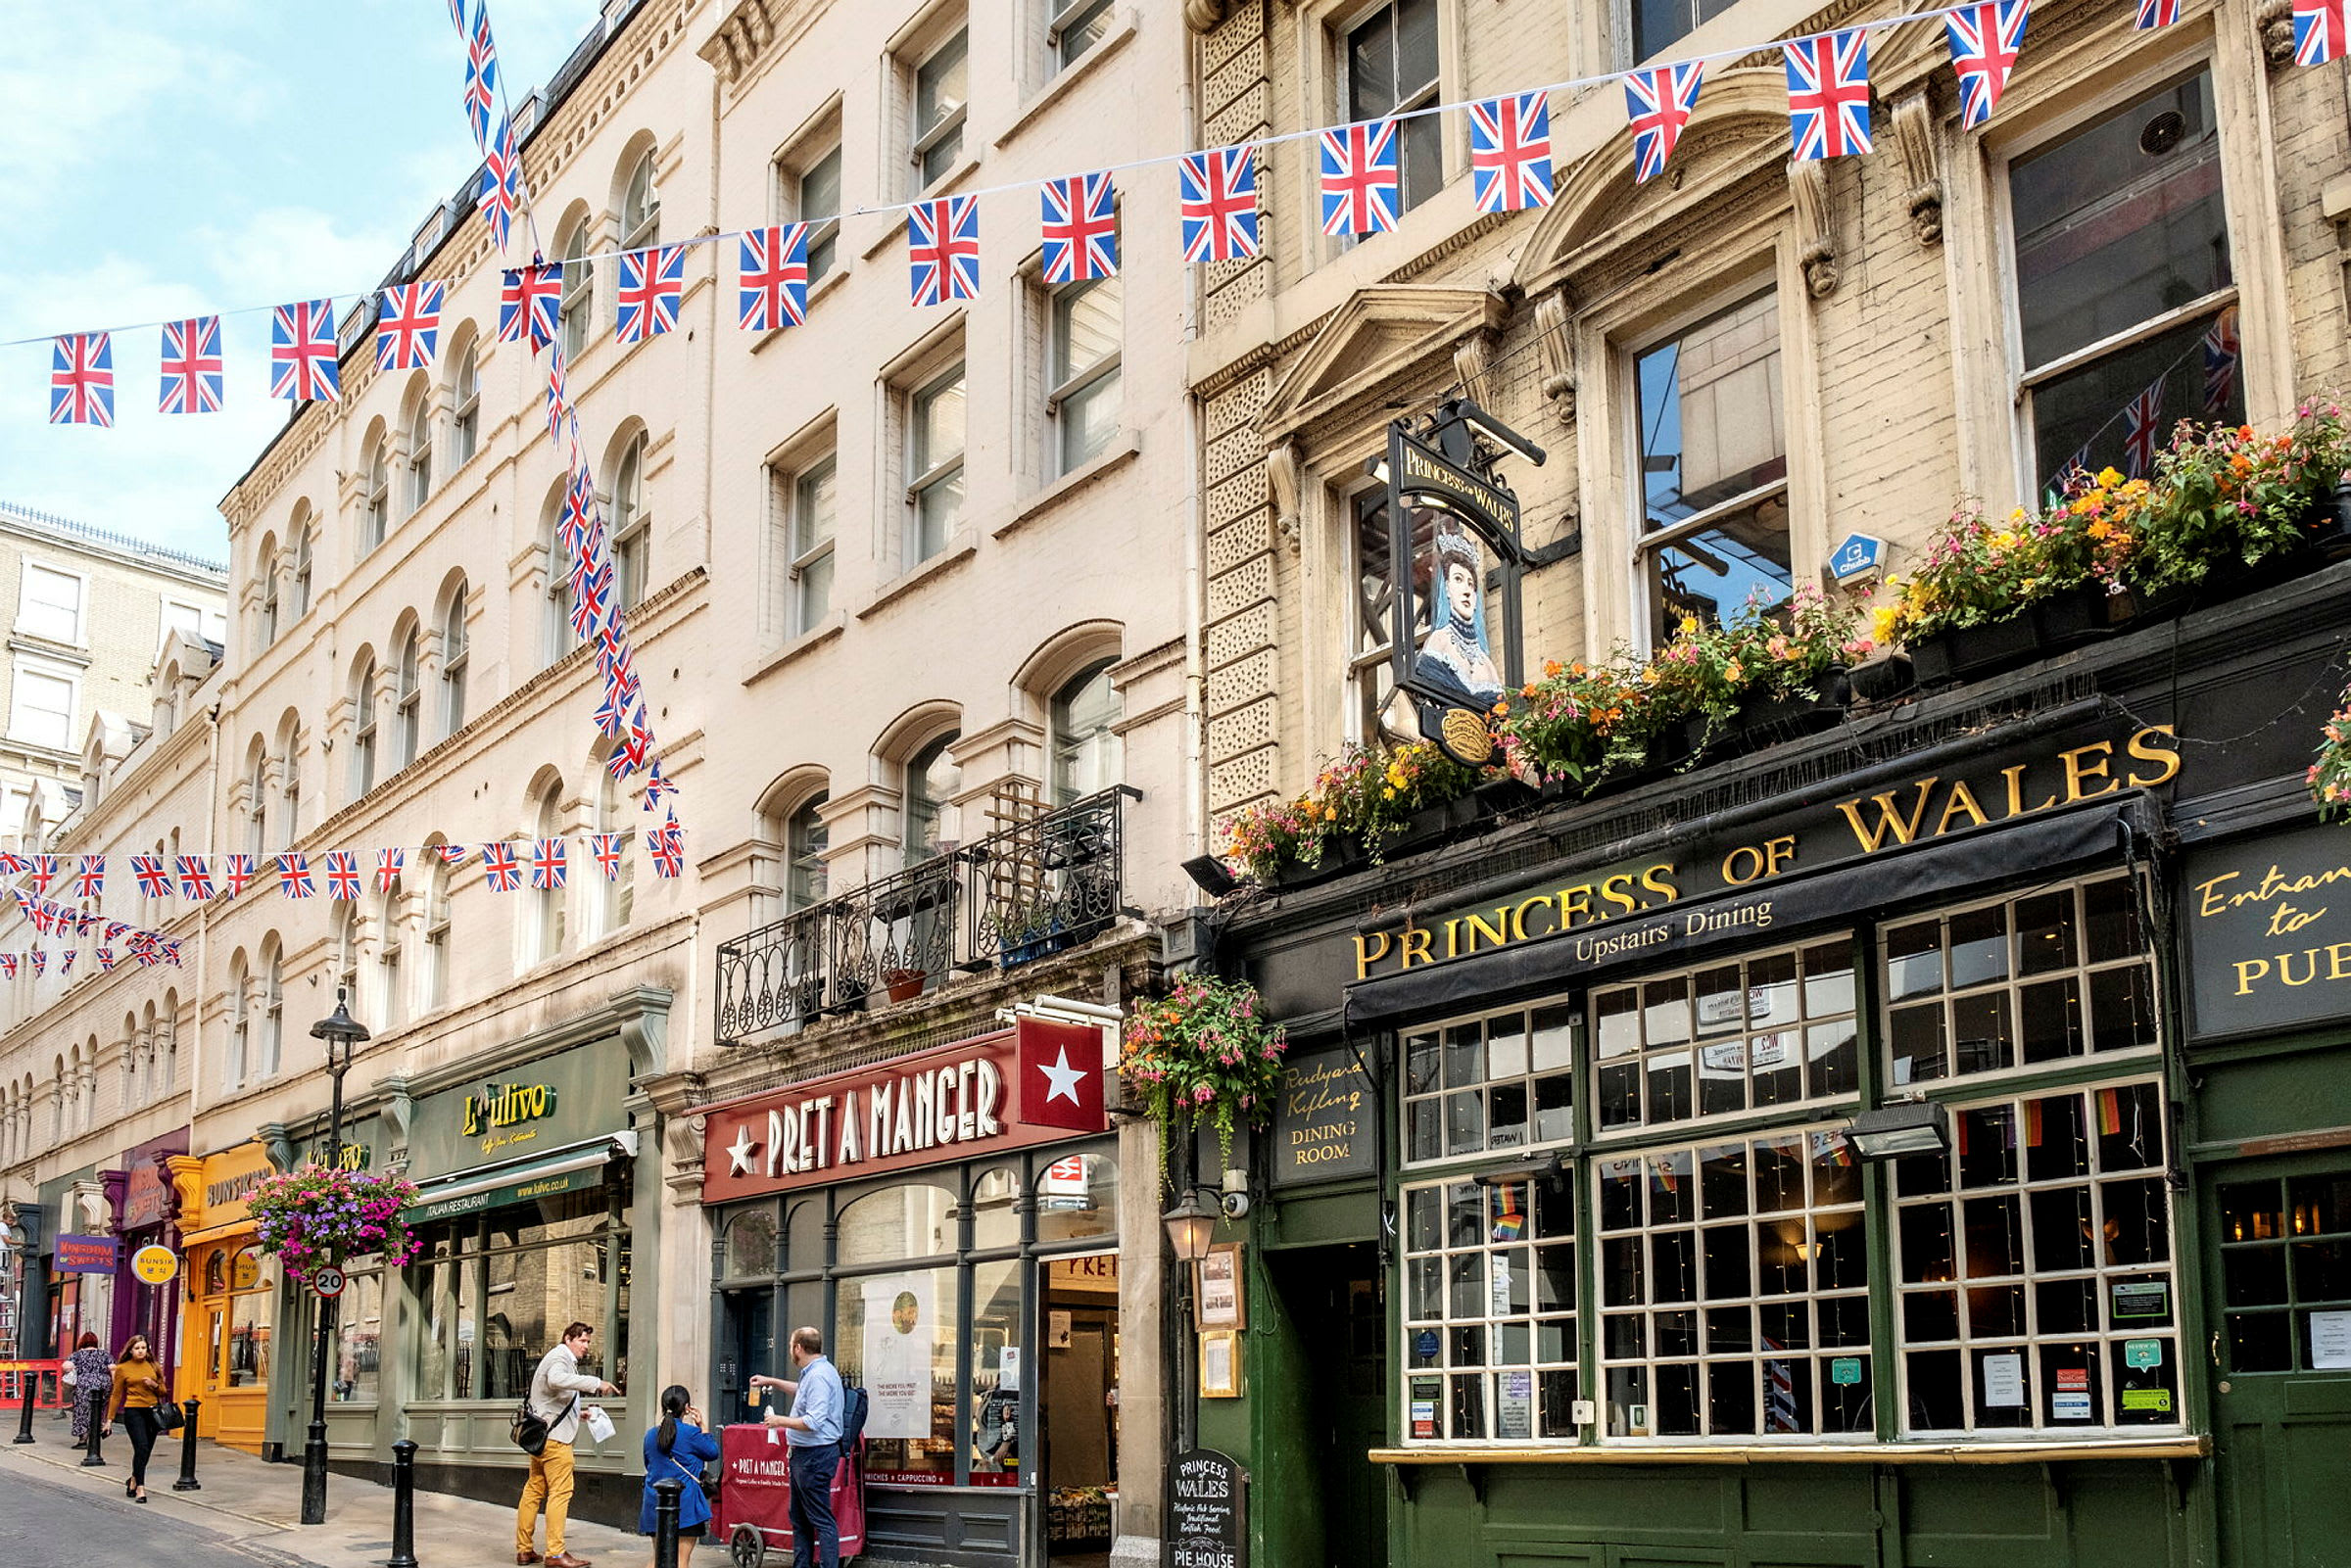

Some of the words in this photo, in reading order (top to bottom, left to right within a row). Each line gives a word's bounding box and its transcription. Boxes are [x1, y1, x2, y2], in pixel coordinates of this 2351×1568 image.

[1405, 447, 1464, 493] PRINCESS
[1474, 486, 1513, 534] WALES
[1841, 555, 1872, 573] Chubb
[1351, 864, 1679, 980] PRINCESS
[1722, 834, 1797, 884] OF
[1835, 724, 2182, 853] WALES
[2265, 901, 2328, 937] to
[1575, 924, 1669, 965] Upstairs
[1685, 901, 1773, 936] Dining
[1287, 1087, 1361, 1121] Kipling
[767, 1094, 836, 1178] PRET
[839, 1089, 863, 1164] A
[870, 1057, 1003, 1158] MANGER
[1291, 1120, 1357, 1145] DINING
[1295, 1143, 1351, 1164] ROOM
[450, 1192, 490, 1212] RESTAURANT
[59, 1240, 114, 1257] KINGDOM
[68, 1255, 115, 1267] SWEETS
[317, 1274, 342, 1288] 20
[739, 1457, 753, 1474] PRET
[754, 1459, 759, 1475] A
[760, 1459, 787, 1476] MANGER
[1179, 1459, 1228, 1480] PRINCESS
[896, 1474, 937, 1483] CAPPUCCINO
[1176, 1479, 1229, 1498] WALES
[1175, 1550, 1193, 1566] PIE
[1195, 1550, 1235, 1568] HOUSE
